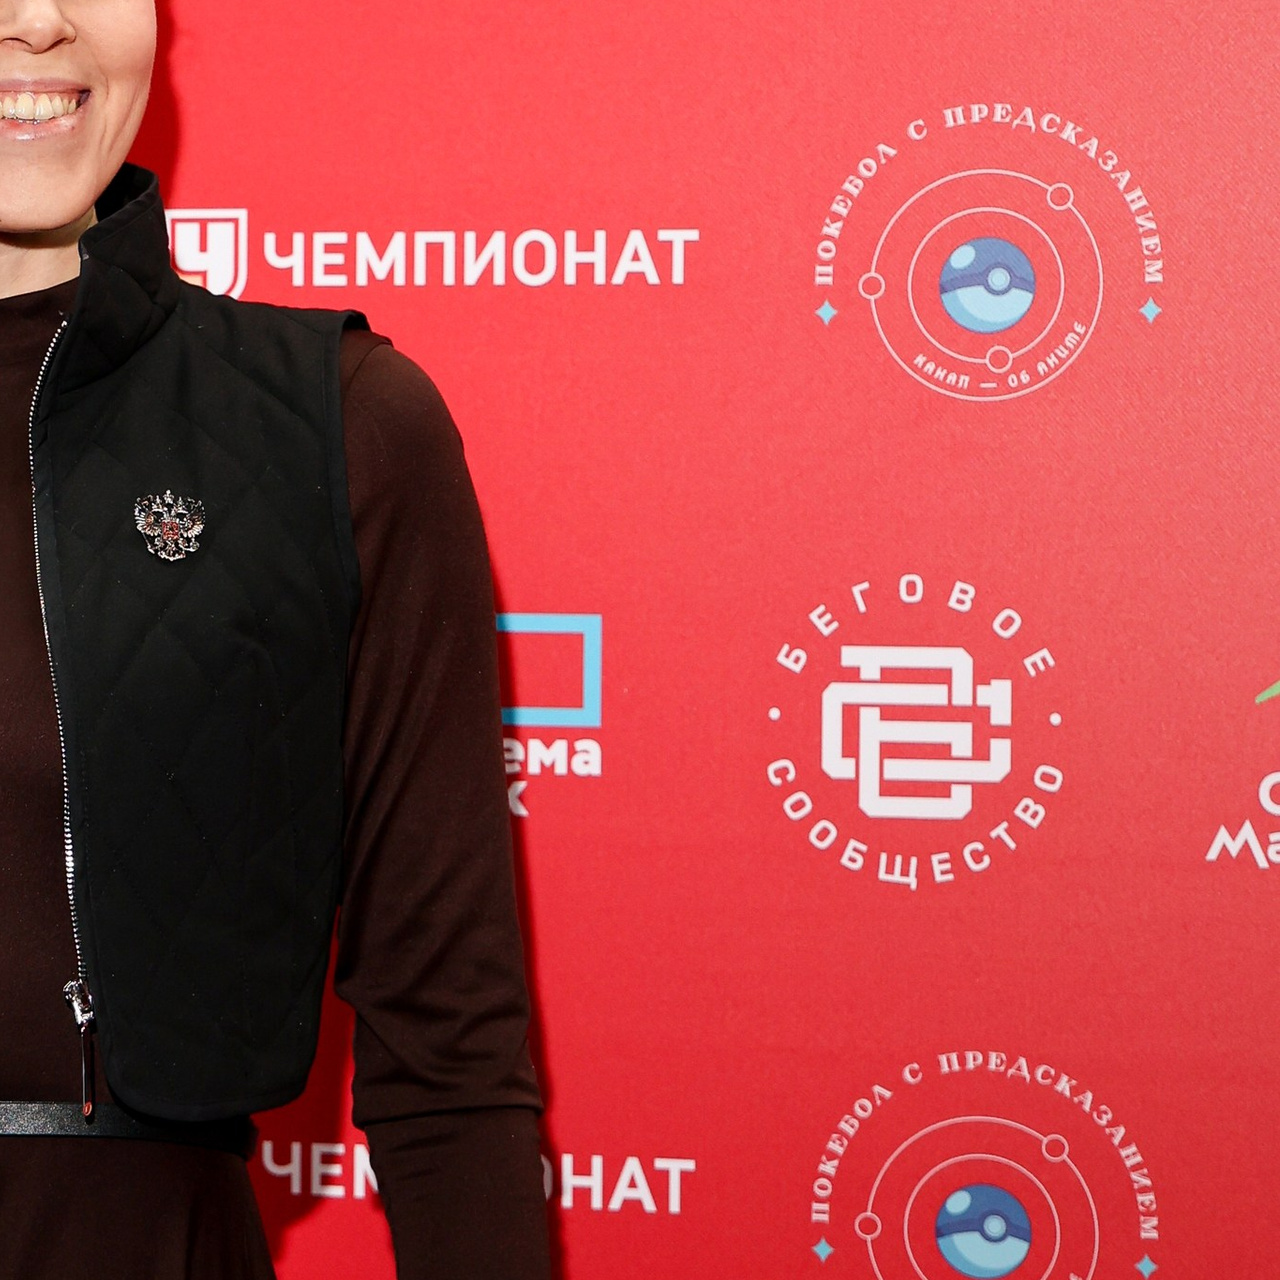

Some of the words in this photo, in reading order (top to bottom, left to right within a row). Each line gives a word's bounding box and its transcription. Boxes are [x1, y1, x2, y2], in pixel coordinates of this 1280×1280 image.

[264, 229, 700, 287] ЧЕМПИОНАТ
[814, 143, 898, 286] ПОКЕБОЛ
[907, 119, 928, 141] С
[943, 103, 1163, 284] ПРЕДСКАЗАНИЕМ
[776, 574, 1055, 677] БЕГОВОЕ
[767, 759, 1063, 891] СООБЩЕСТВО
[811, 1084, 894, 1224] ПОКЕБОЛ
[902, 1063, 923, 1085] С
[938, 1051, 1159, 1240] ПРЕДСКАЗАНИЕМ
